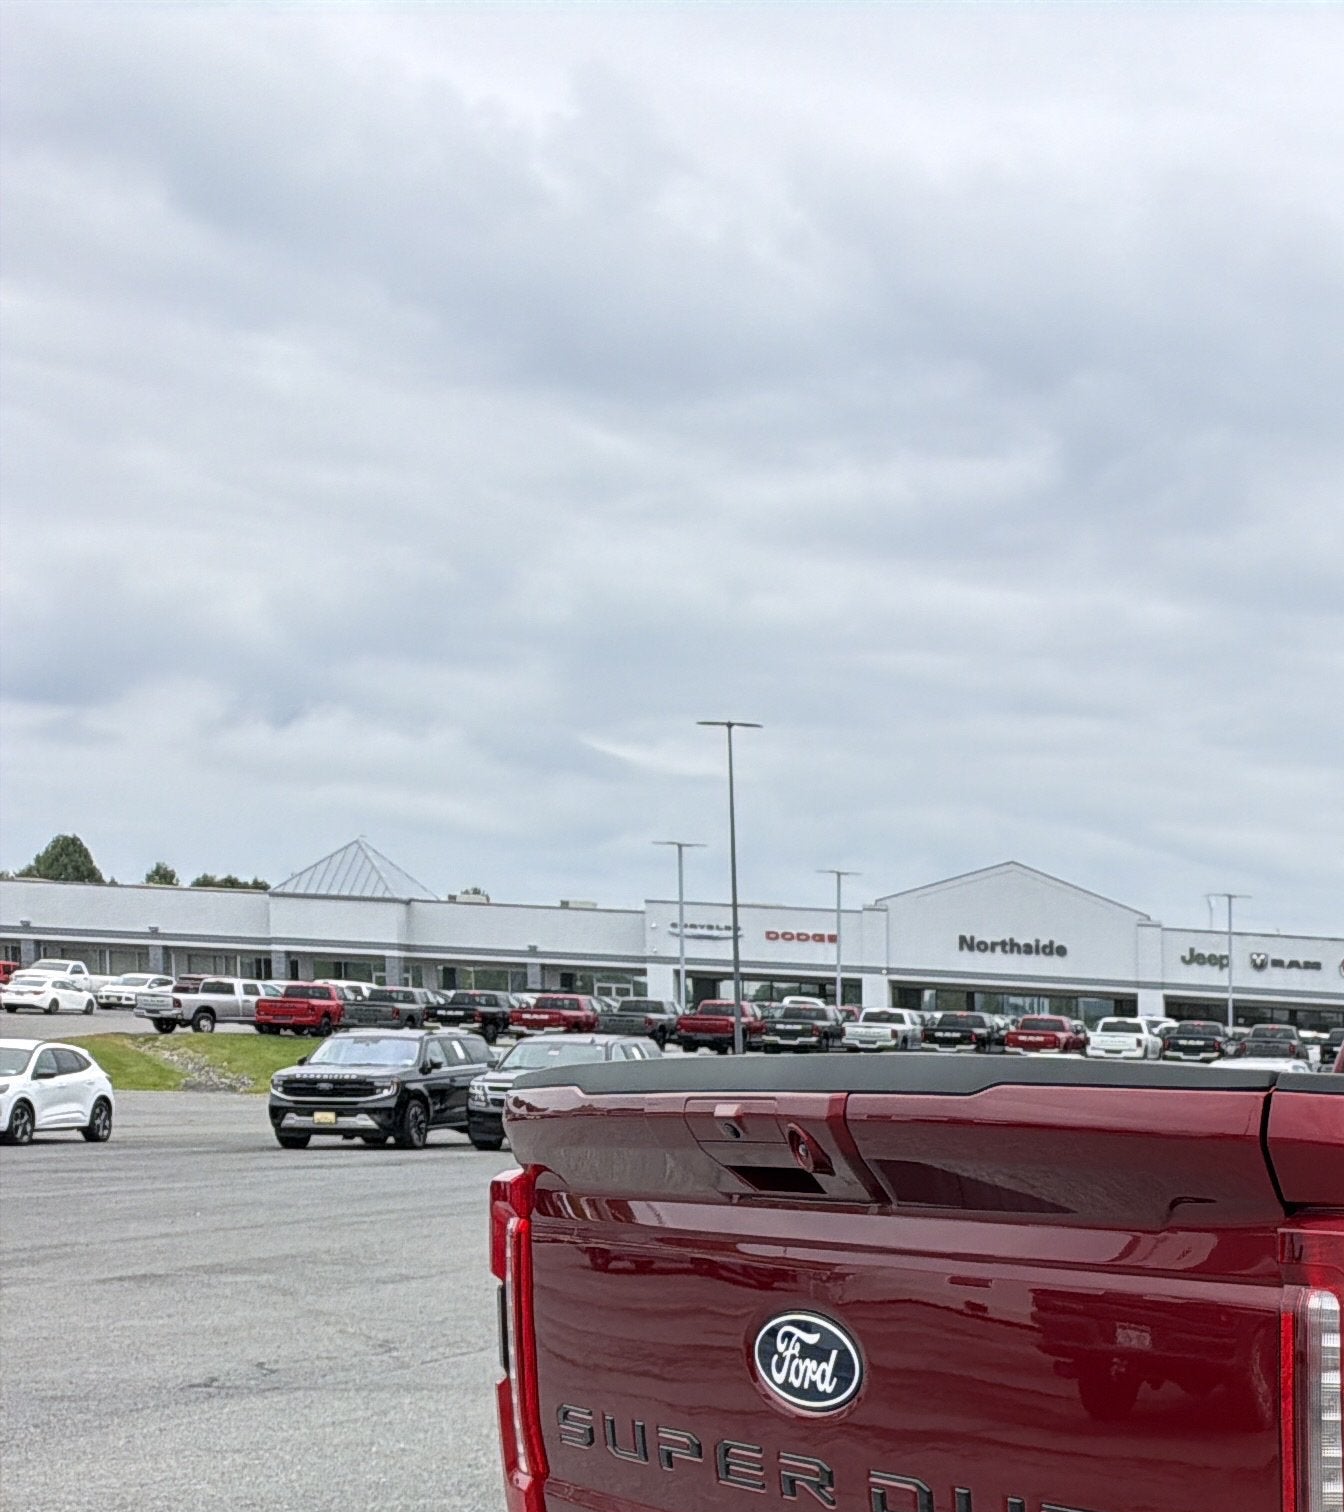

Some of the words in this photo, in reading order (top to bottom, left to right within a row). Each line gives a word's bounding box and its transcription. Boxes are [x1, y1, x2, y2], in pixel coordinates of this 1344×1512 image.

[765, 930, 838, 943] DODGE
[958, 934, 1068, 958] Northside
[1181, 947, 1230, 971] Jeep
[1270, 958, 1322, 971] RAM
[770, 1329, 839, 1395] Ford
[556, 1403, 837, 1509] SUPER
